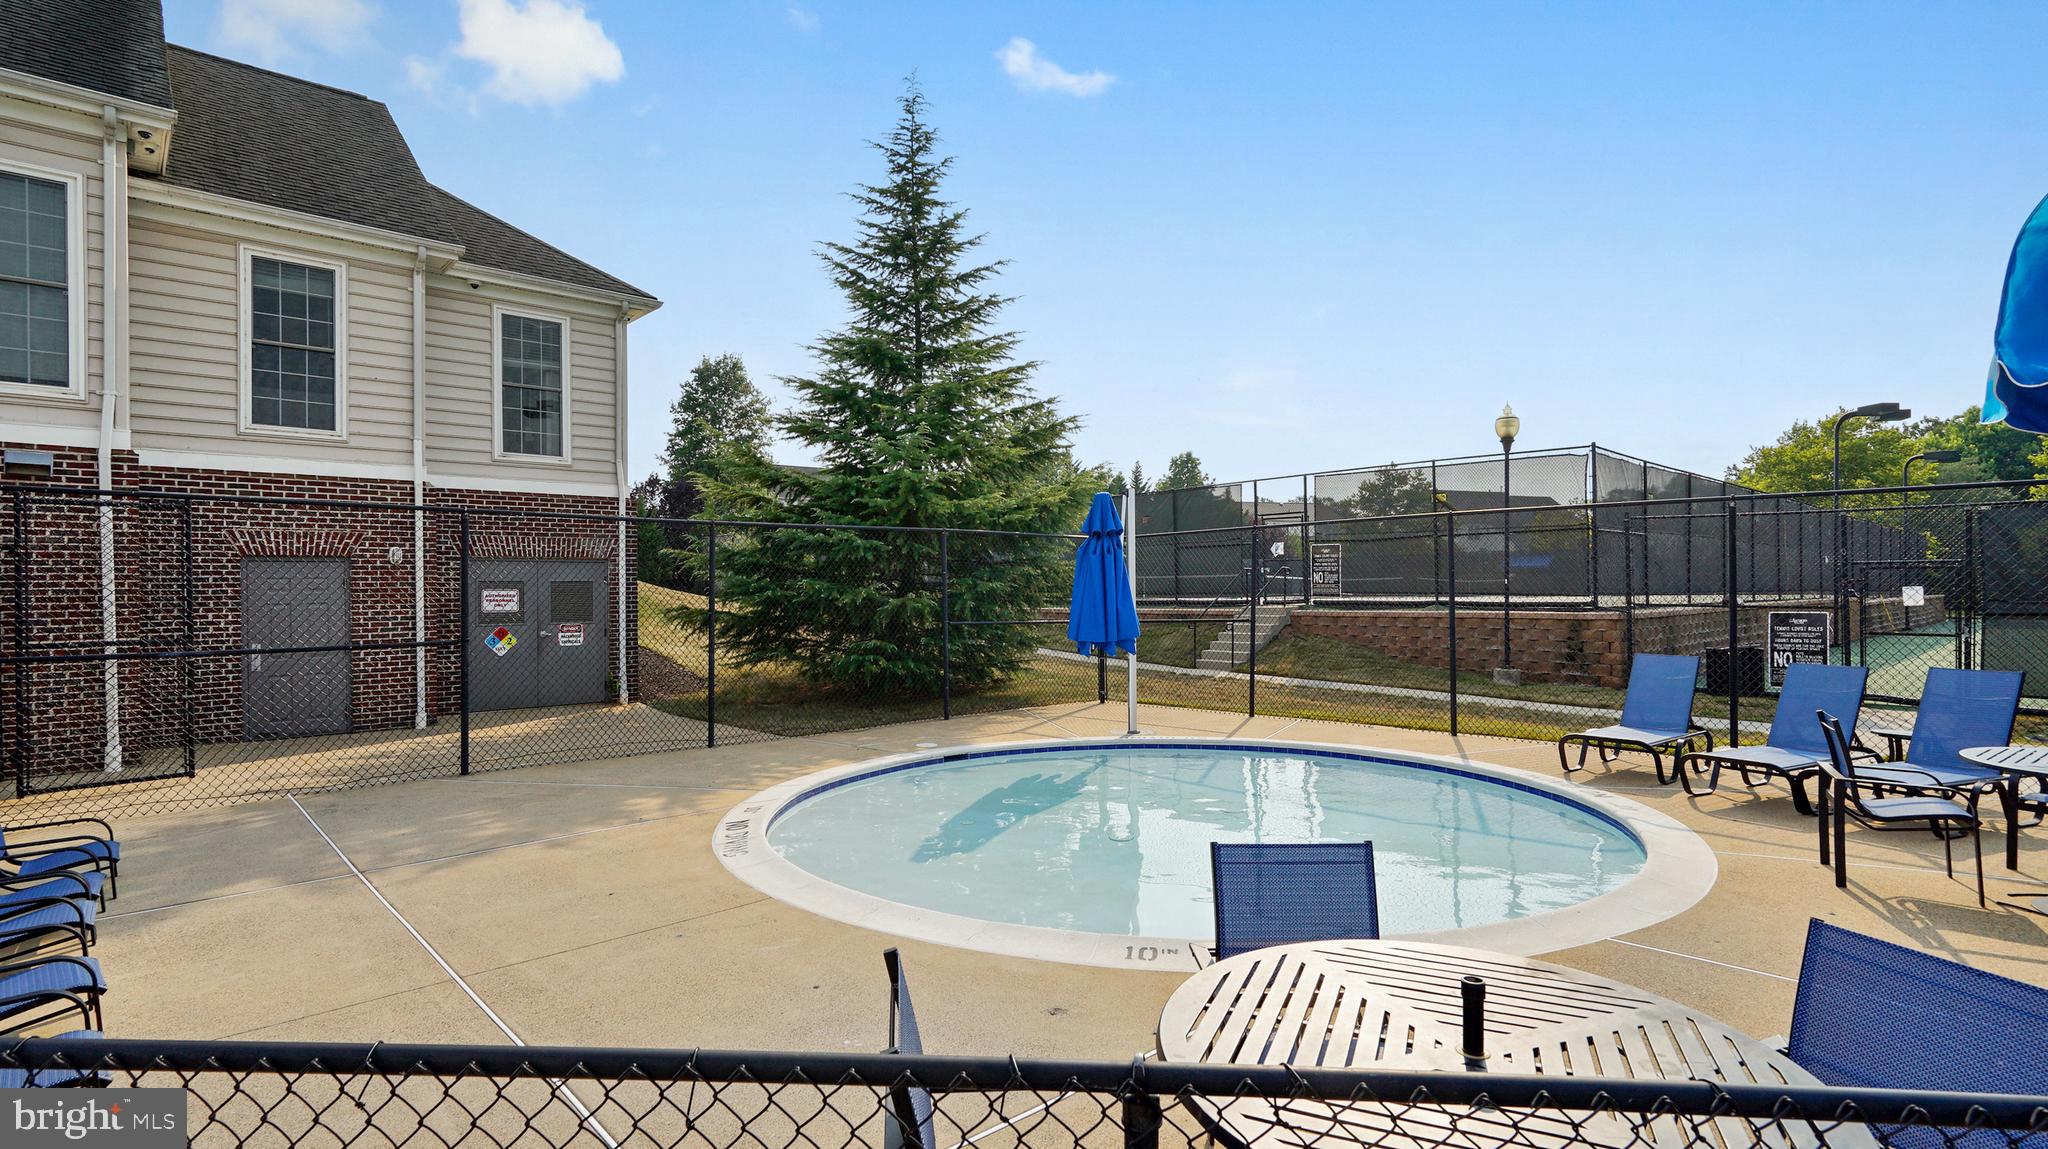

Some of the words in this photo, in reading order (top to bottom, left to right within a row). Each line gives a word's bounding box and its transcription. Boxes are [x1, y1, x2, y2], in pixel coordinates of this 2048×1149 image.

[1313, 571, 1324, 584] NO
[506, 637, 512, 645] 2
[1773, 651, 1793, 667] NO
